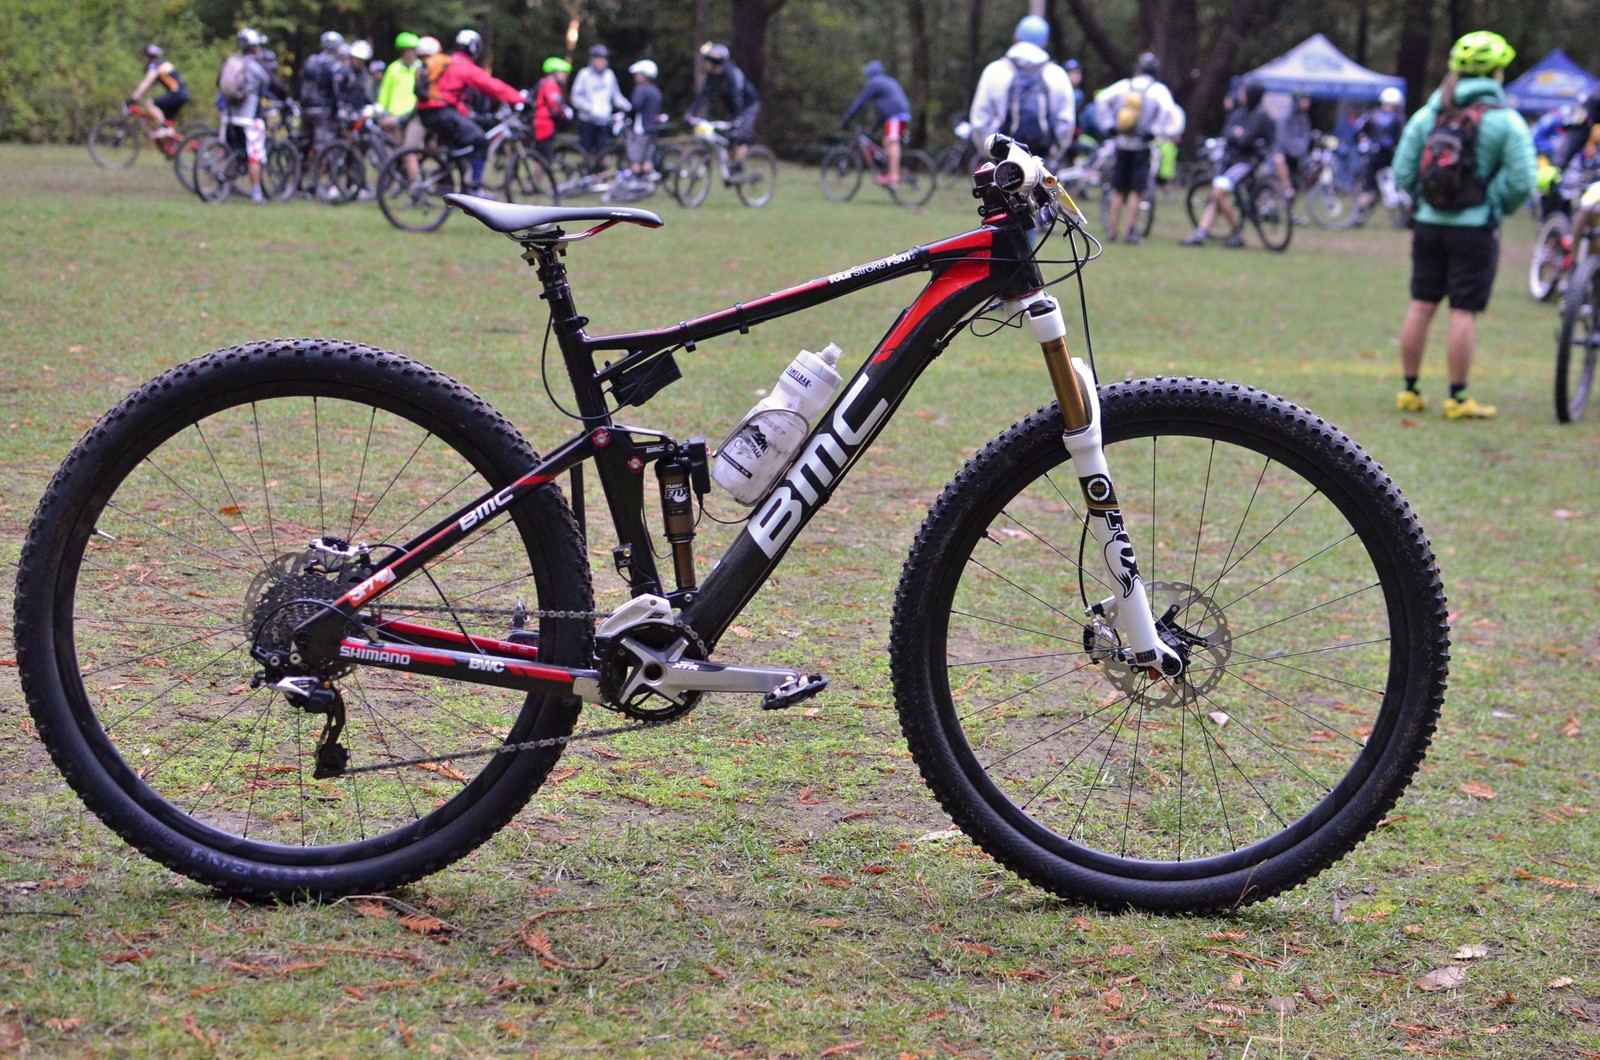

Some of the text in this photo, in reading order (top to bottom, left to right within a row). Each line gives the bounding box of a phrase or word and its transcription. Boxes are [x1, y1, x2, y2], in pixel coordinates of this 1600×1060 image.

[747, 372, 889, 560] BMC
[458, 486, 514, 532] BMC
[664, 487, 689, 503] FOX
[339, 645, 411, 666] SHIMANO
